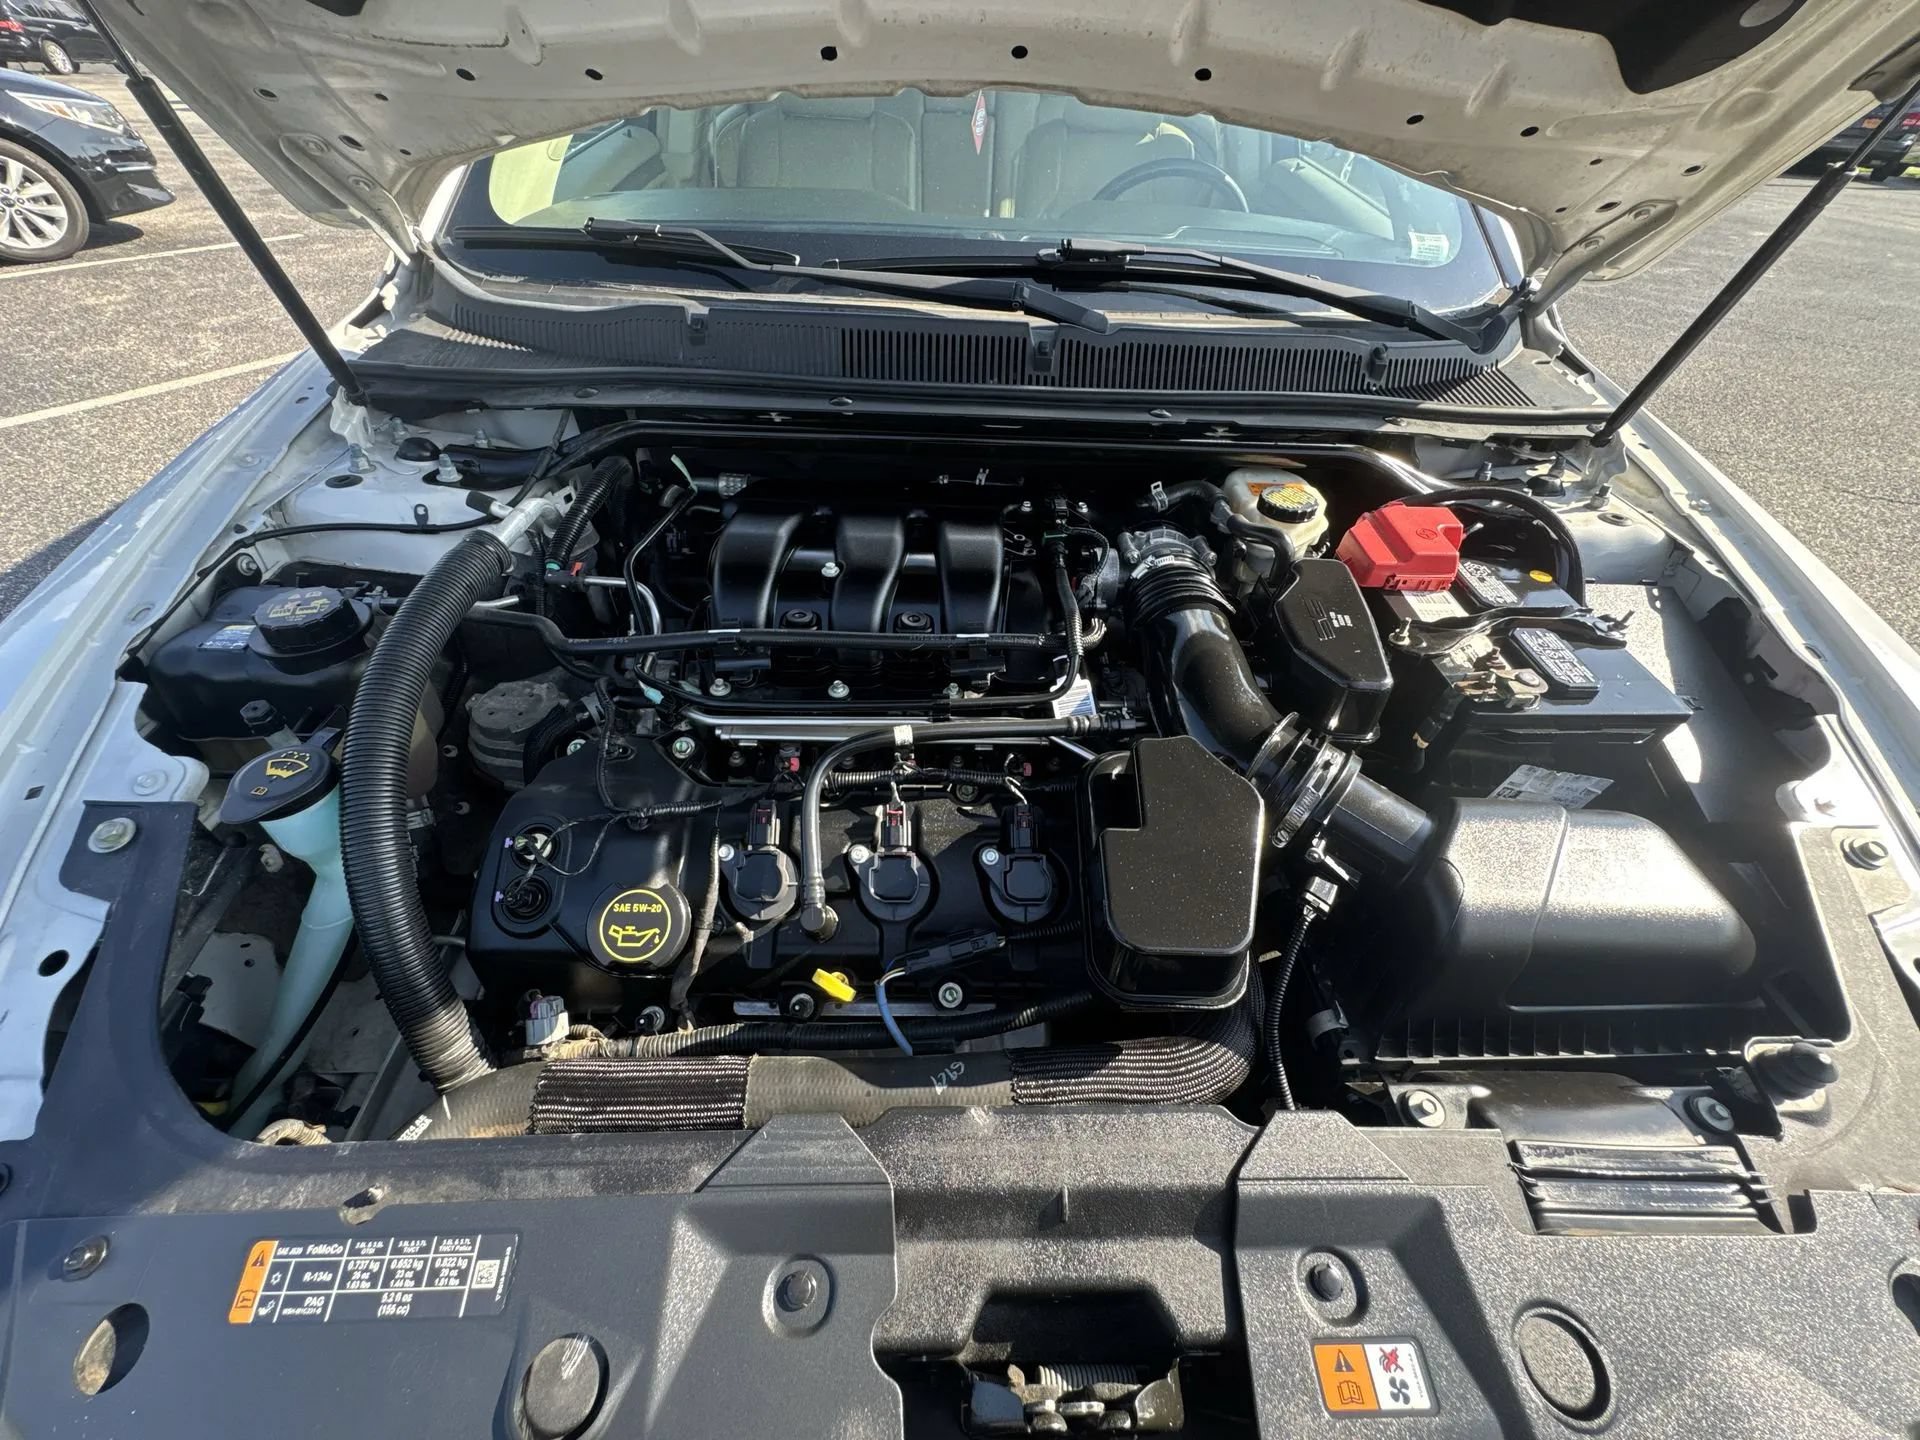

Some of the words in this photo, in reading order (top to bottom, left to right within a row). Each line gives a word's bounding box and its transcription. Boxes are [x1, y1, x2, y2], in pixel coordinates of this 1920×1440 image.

[613, 903, 631, 912] SAE
[632, 903, 662, 913] 5W-20
[305, 1243, 344, 1255] FoMoCo
[347, 1260, 369, 1271] 0.737
[369, 1260, 381, 1273] kg
[390, 1259, 412, 1269] 0.652
[412, 1258, 424, 1271] kg
[434, 1257, 457, 1268] 0.822
[457, 1257, 469, 1270] kg
[302, 1271, 333, 1282] R-134a
[351, 1271, 360, 1280] 26
[360, 1272, 370, 1280] oz
[395, 1270, 404, 1279] 23
[404, 1270, 414, 1278] oz
[449, 1269, 458, 1277] oz
[303, 1295, 326, 1307] PAG
[393, 1292, 402, 1303] fl
[402, 1293, 413, 1302] oz
[377, 1304, 396, 1318] (155
[396, 1304, 411, 1317] cc)
